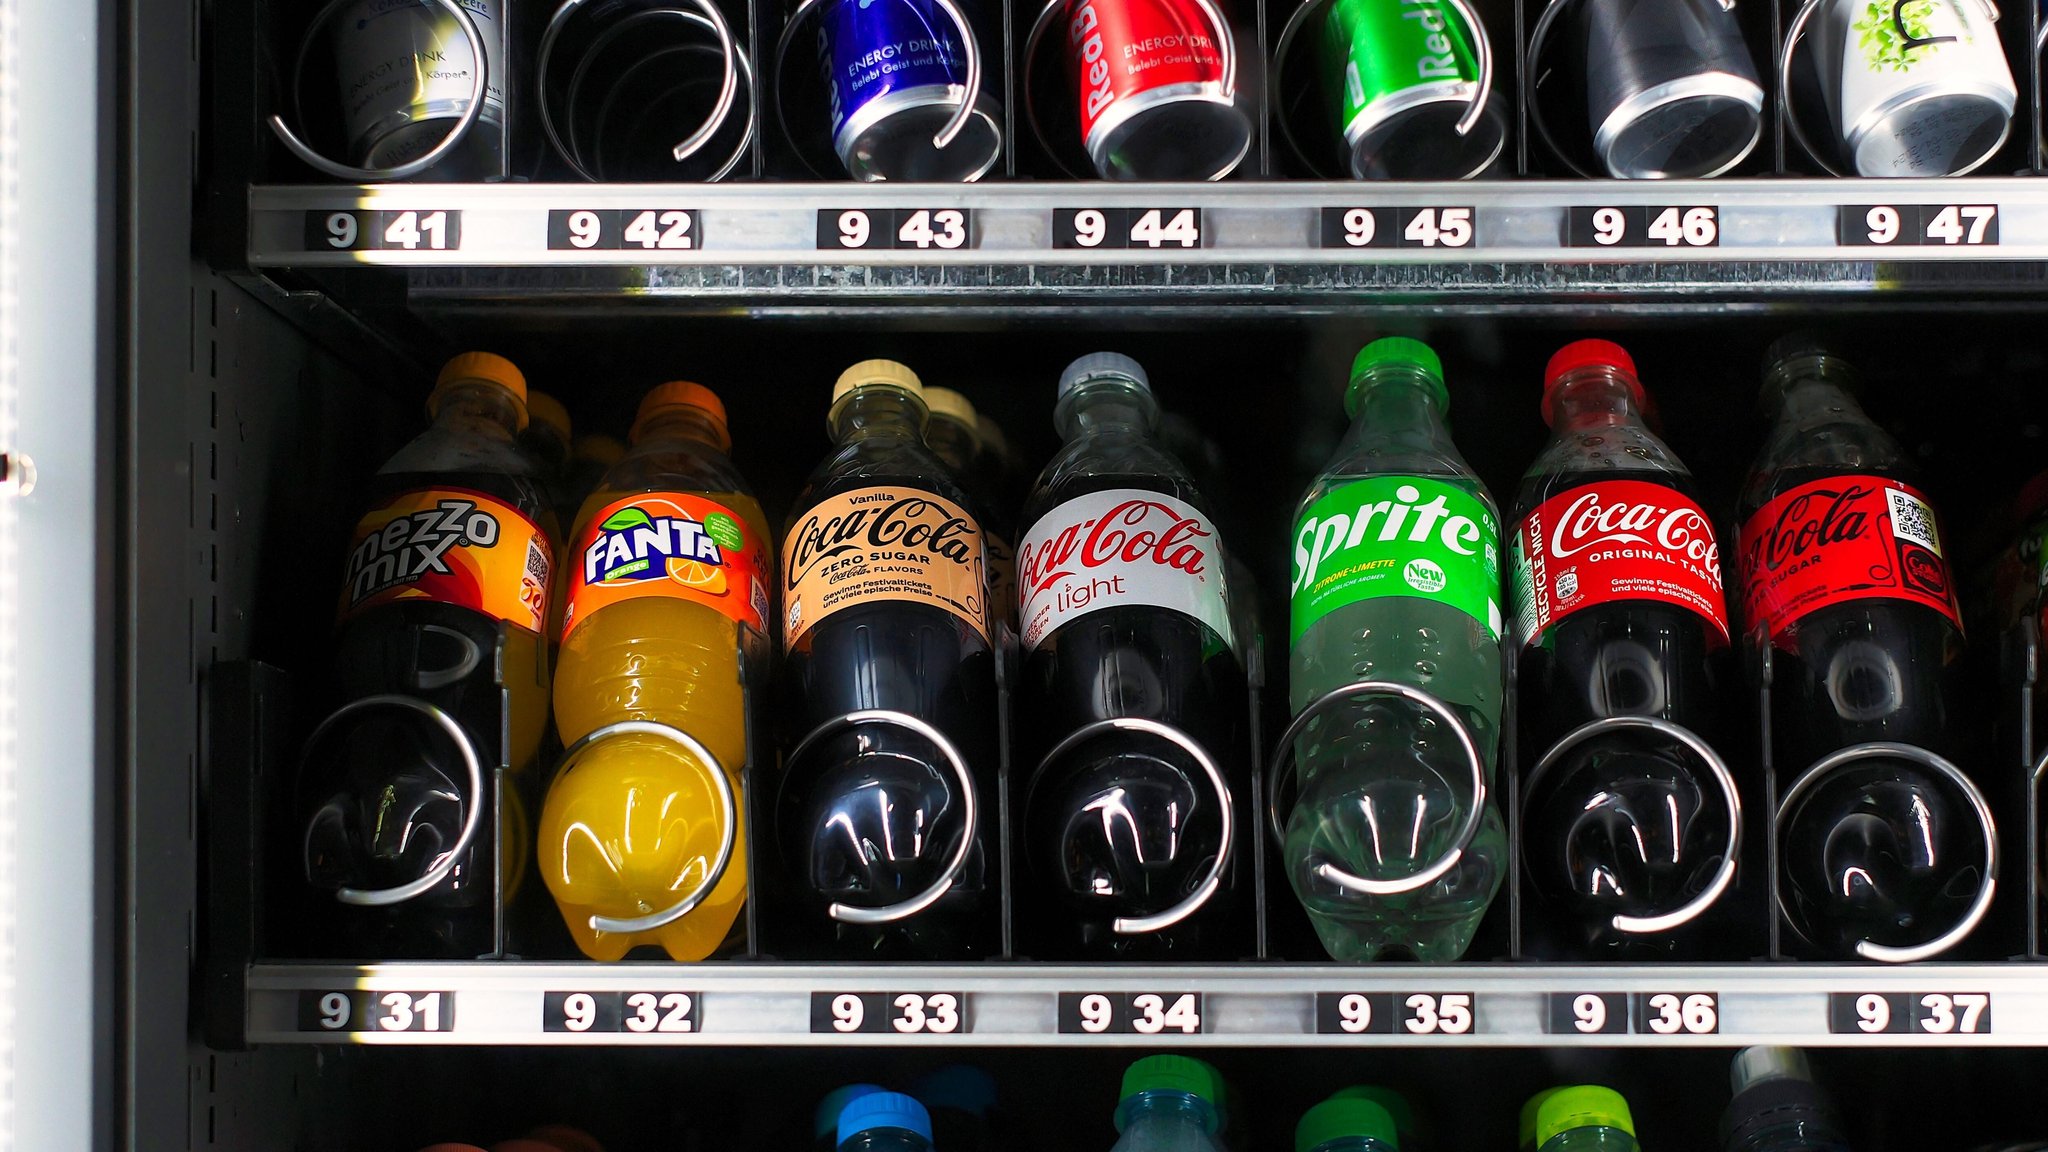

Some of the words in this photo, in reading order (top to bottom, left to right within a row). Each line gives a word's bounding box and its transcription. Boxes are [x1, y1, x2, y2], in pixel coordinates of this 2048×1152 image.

[848, 42, 903, 78] ENERGY
[1123, 34, 1184, 59] ENERGY
[1189, 35, 1214, 49] DRI
[1402, 9, 1459, 79] Red
[852, 68, 880, 92] Belebt
[882, 59, 910, 75] Geist
[913, 55, 933, 67] und
[1127, 57, 1160, 75] Belebt
[1164, 54, 1192, 65] Geist
[1194, 55, 1213, 65] und
[328, 213, 358, 248] 9
[385, 211, 447, 249] 41
[569, 211, 600, 248] 9
[625, 211, 691, 248] 42
[839, 211, 869, 247] 9
[899, 211, 965, 248] 43
[1075, 210, 1105, 246] 9
[1131, 210, 1197, 247] 44
[1344, 209, 1374, 245] 9
[1405, 209, 1471, 246] 45
[1593, 208, 1624, 244] 9
[1649, 208, 1716, 245] 46
[1867, 207, 1899, 243] 9
[1927, 206, 1995, 243] 47
[849, 492, 895, 505] Vanilla
[347, 502, 497, 586] mezzo
[587, 518, 721, 583] FANTA
[788, 497, 976, 592] Coca-Cola
[1291, 485, 1480, 600] Sprite
[1529, 512, 1545, 555] MICH
[607, 561, 648, 580] Orange
[820, 555, 864, 578] ZERO
[869, 552, 931, 565] SUGAR
[829, 564, 870, 585] Coca-Cola
[874, 566, 924, 575] FLAVORS
[1313, 559, 1396, 594] ZITRONE-LIMETTE
[1358, 573, 1386, 583] AROMEN
[1408, 563, 1443, 583] New
[1408, 577, 1443, 589] Irresistible
[1589, 549, 1676, 565] ORIGINAL
[1680, 558, 1719, 593] TASTE
[1771, 554, 1822, 589] SUGAR
[822, 582, 862, 602] Gewinne
[863, 579, 932, 591] Festivaltickets
[822, 595, 840, 609] und
[840, 589, 862, 602] viele
[863, 585, 901, 596] epische
[903, 586, 933, 597] Preise
[1057, 574, 1126, 613] light
[1534, 554, 1551, 627] RECYCLE
[1611, 578, 1654, 586] Gewinne
[1656, 579, 1713, 609] Festivaltickets
[1611, 585, 1631, 593] und
[1632, 584, 1656, 593] viele
[1658, 587, 1691, 602] epische
[1693, 596, 1714, 617] Preise
[321, 993, 350, 1029] 9
[379, 993, 441, 1032] 31
[564, 993, 595, 1031] 9
[625, 993, 691, 1031] 32
[832, 995, 863, 1031] 9
[893, 994, 958, 1032] 33
[1080, 995, 1111, 1032] 9
[1133, 995, 1199, 1033] 34
[1339, 995, 1370, 1032] 9
[1406, 995, 1471, 1033] 35
[1573, 995, 1605, 1032] 9
[1649, 994, 1716, 1033] 36
[1856, 994, 1889, 1032] 9
[1920, 994, 1987, 1033] 37
